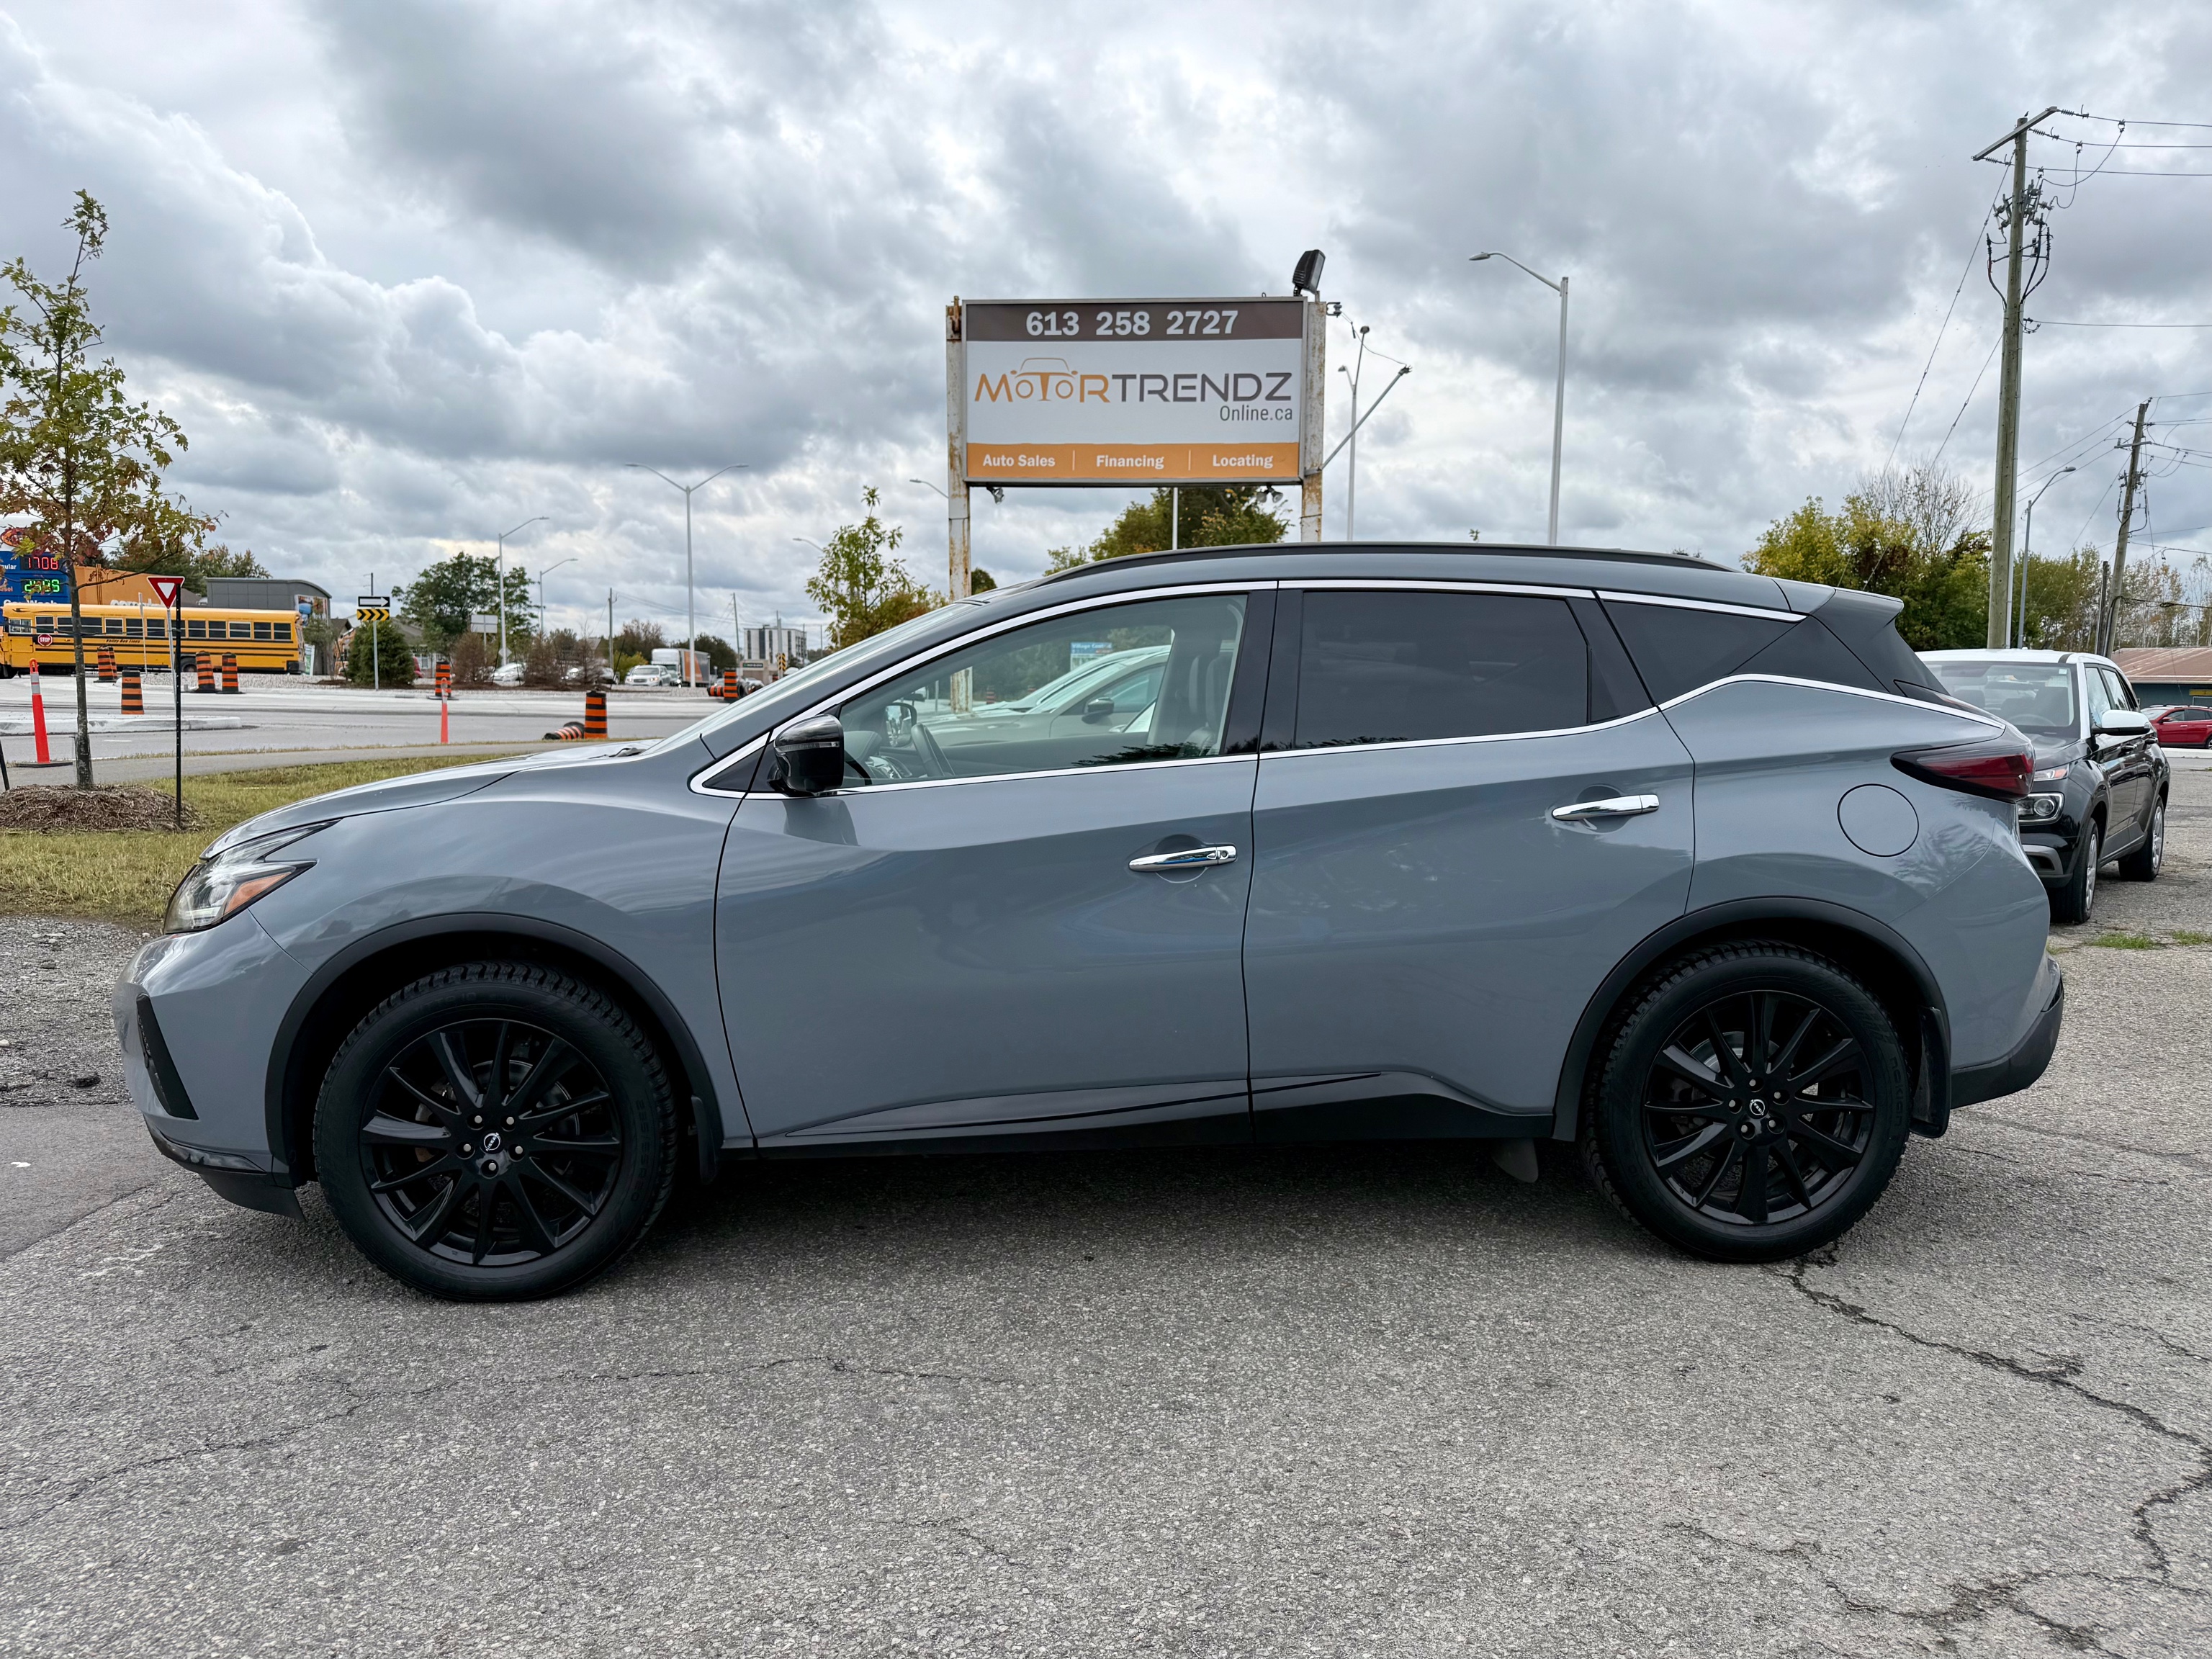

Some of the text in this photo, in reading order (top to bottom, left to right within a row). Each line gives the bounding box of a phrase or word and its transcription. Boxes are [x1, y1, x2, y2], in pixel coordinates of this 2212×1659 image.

[1026, 310, 1238, 336] 613 258 2727
[1220, 404, 1293, 421] Online.ca
[983, 454, 1056, 467] Auto Sales
[1096, 454, 1164, 469] Financing
[1213, 454, 1274, 469] Locating
